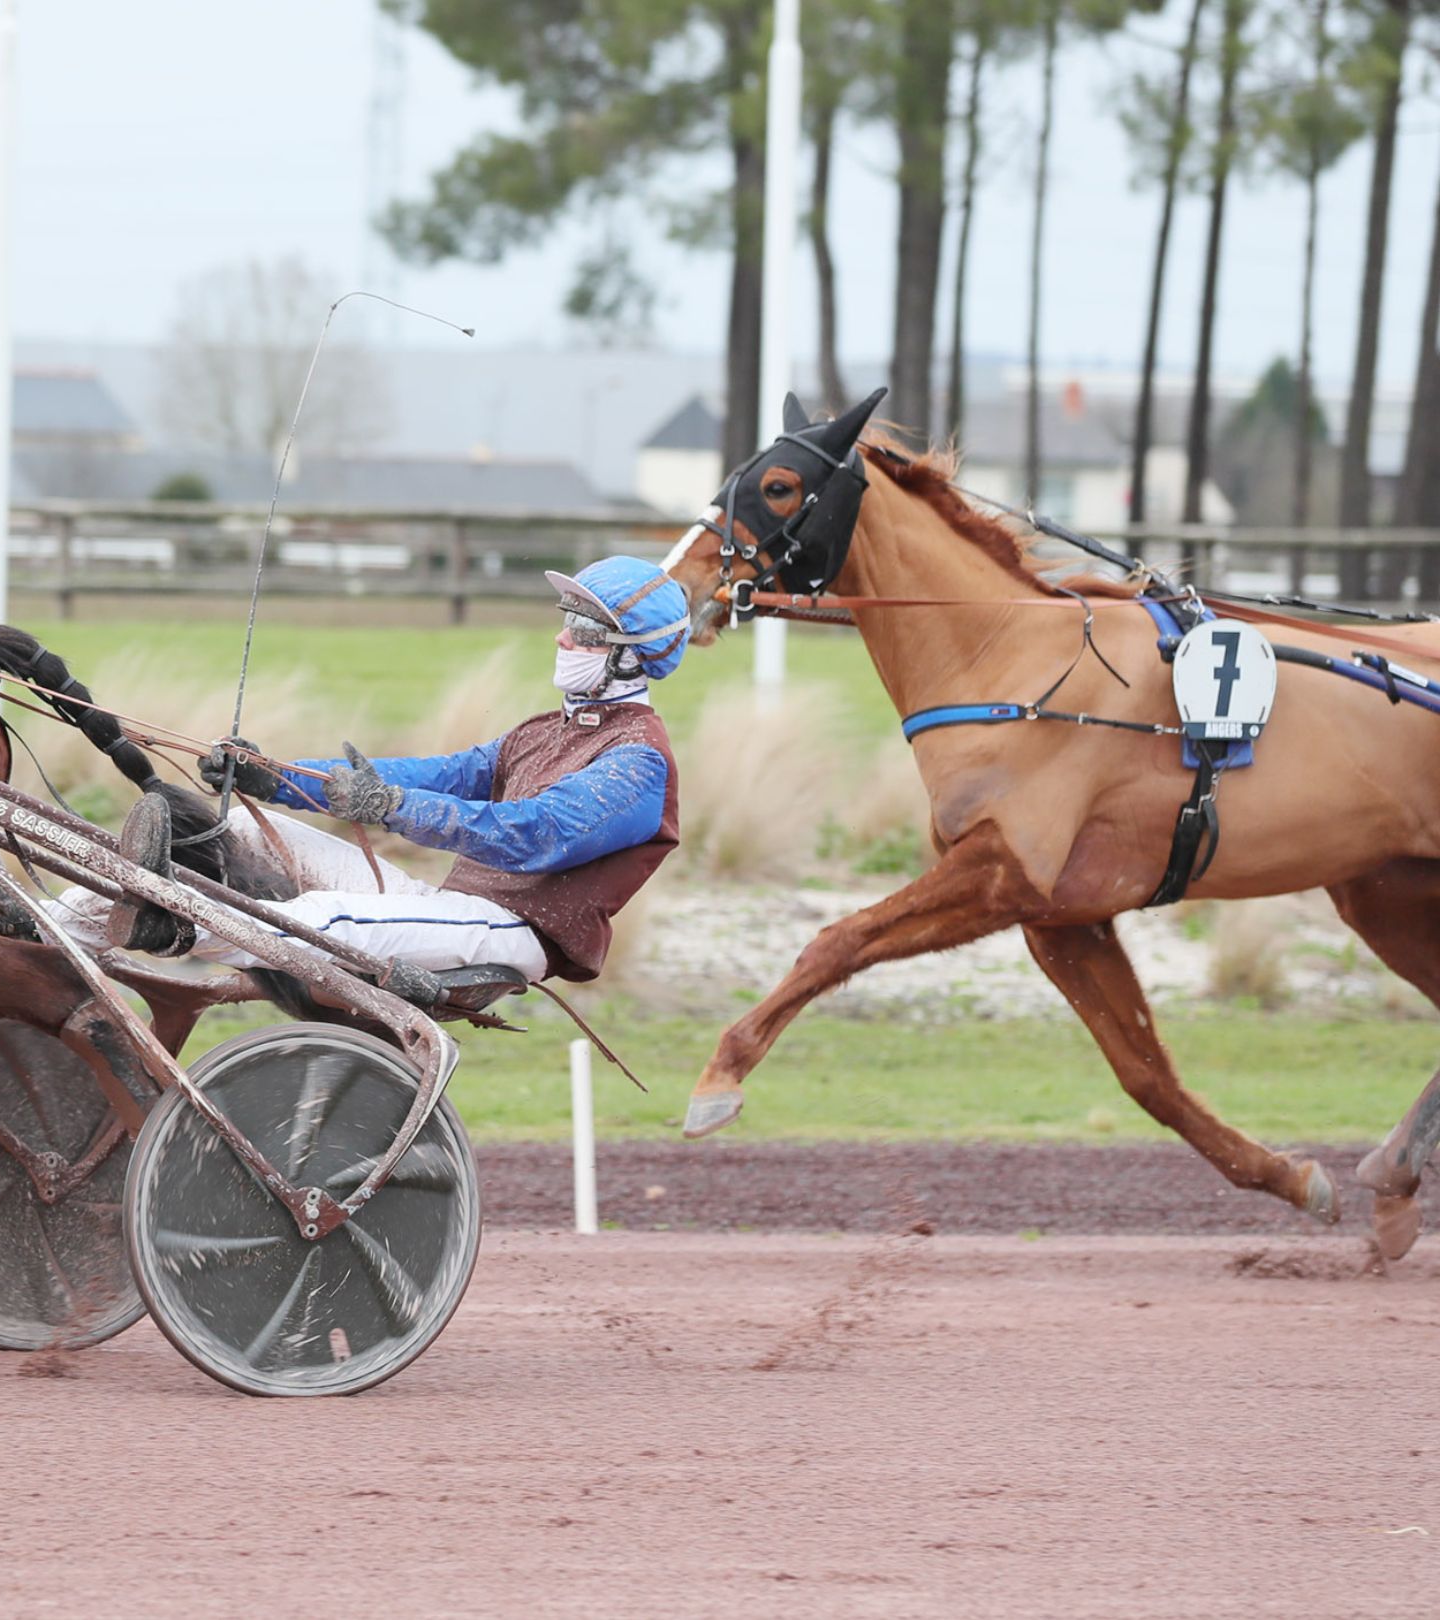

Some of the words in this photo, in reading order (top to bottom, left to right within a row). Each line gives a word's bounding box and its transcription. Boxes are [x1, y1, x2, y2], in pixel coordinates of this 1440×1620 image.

[1211, 631, 1241, 717] 7
[1204, 722, 1243, 738] ANGERS
[10, 806, 93, 859] SASSIER
